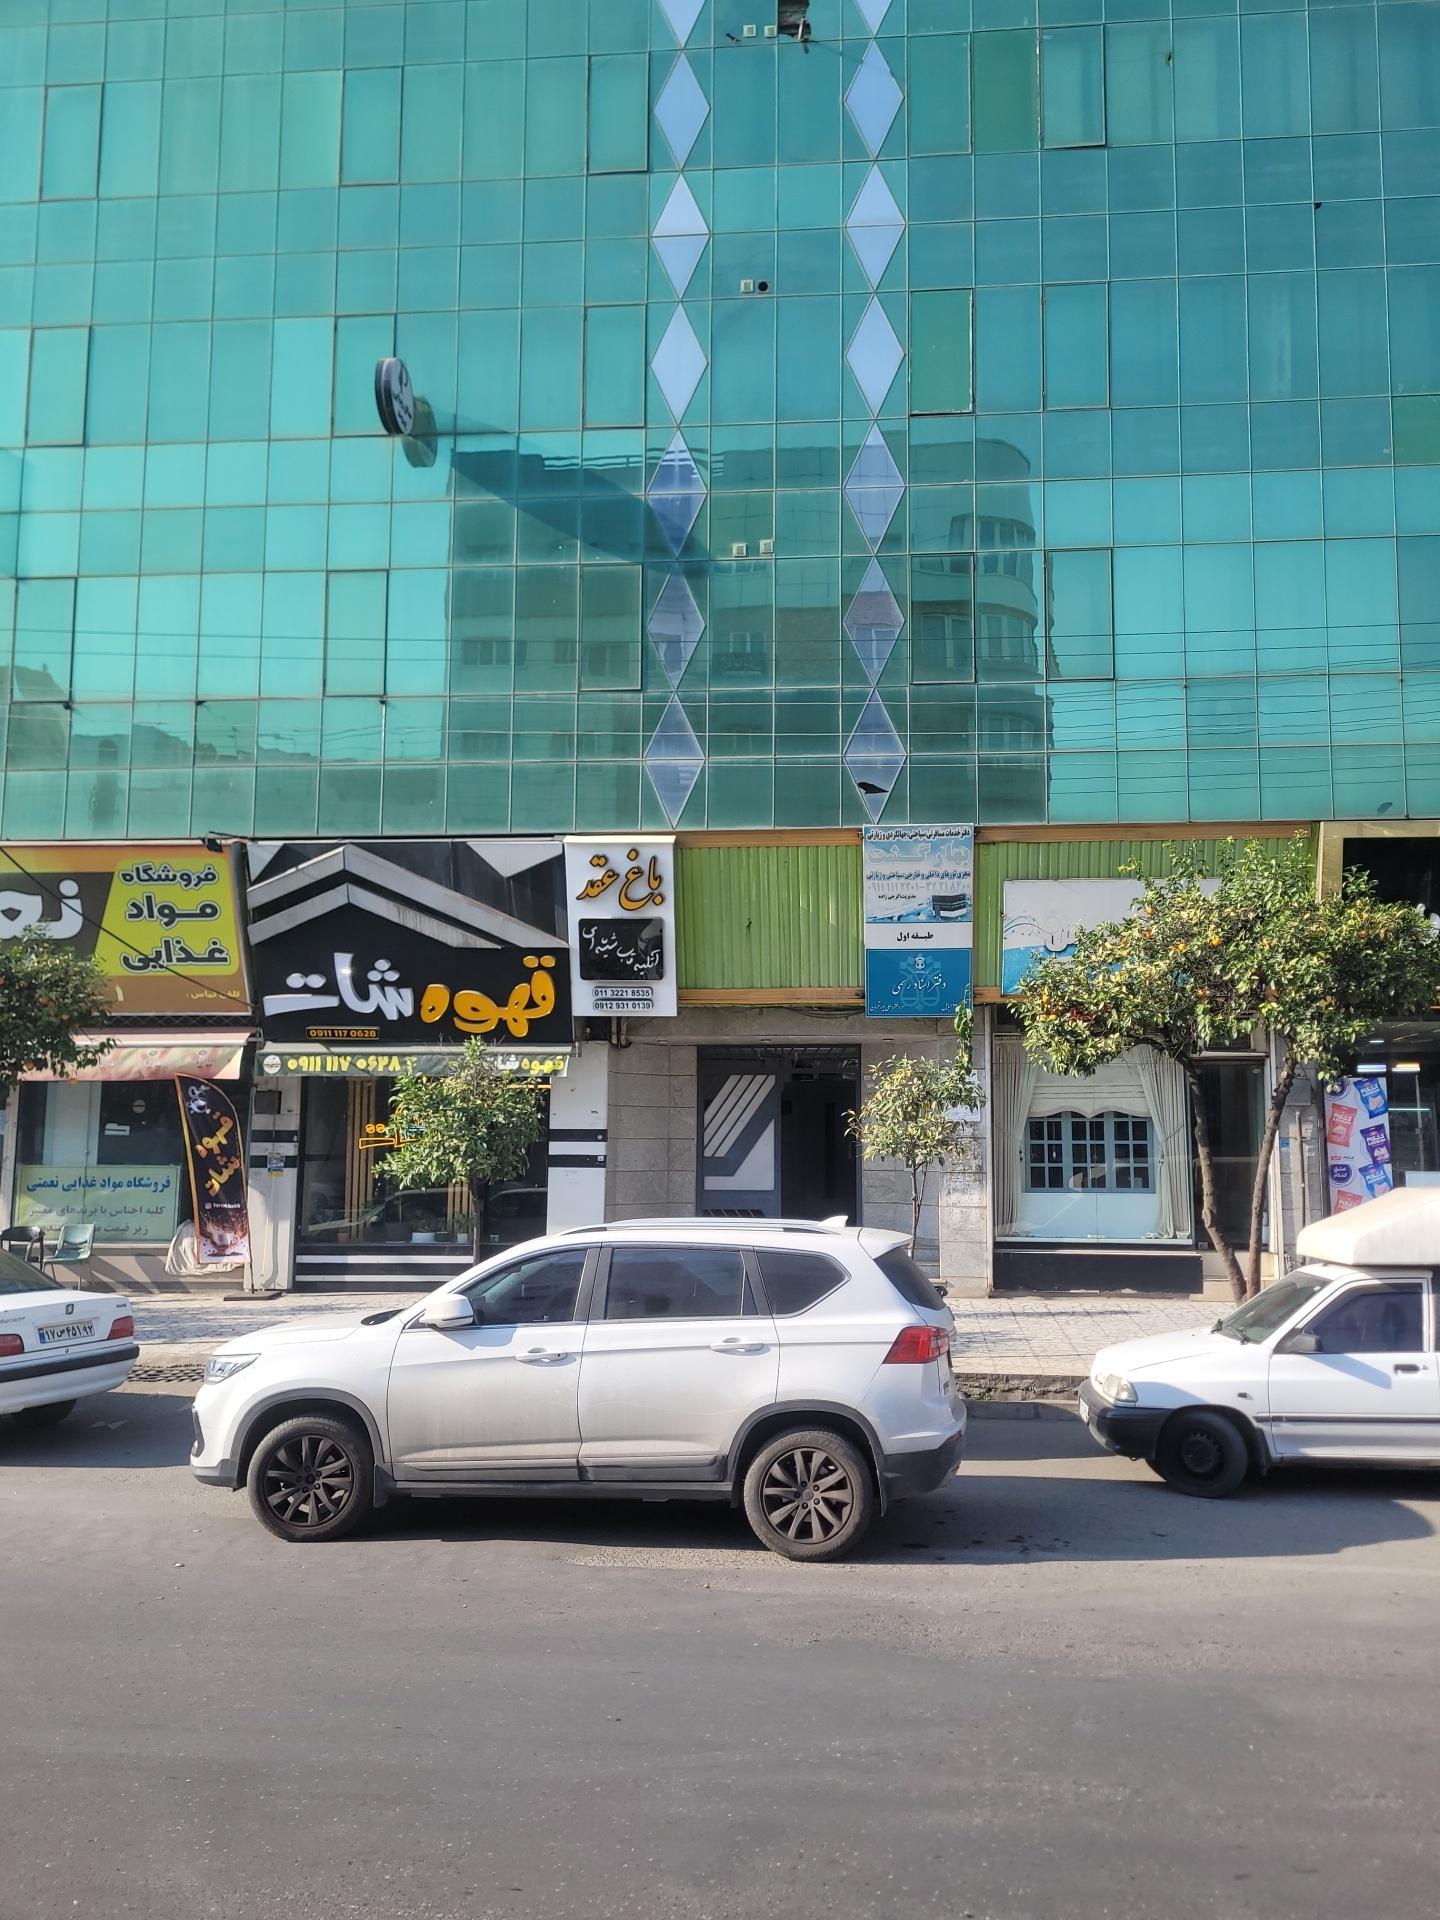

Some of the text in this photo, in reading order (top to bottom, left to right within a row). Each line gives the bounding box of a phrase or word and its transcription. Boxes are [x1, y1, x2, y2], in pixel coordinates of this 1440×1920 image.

[121, 863, 217, 889] فروشگاه
[576, 848, 664, 911] باغ عقد
[127, 894, 219, 928] مواد
[897, 932, 933, 941] طبقه اول
[121, 939, 229, 971] غذایی
[617, 946, 637, 965] قاب
[891, 973, 946, 995] دفتر اسناد رسمی
[262, 952, 557, 1038] قهوه شات
[309, 1029, 332, 1037] 0911
[334, 1029, 347, 1037] 117
[287, 1056, 321, 1072] ۰۹۱۱
[326, 1056, 352, 1072] ۱۱۷
[521, 1055, 564, 1075] قهوه
[195, 1111, 234, 1158] قهوه
[26, 1175, 171, 1193] فروشگاه مواد غذایی نعمتی
[103, 1225, 130, 1233] قیمت
